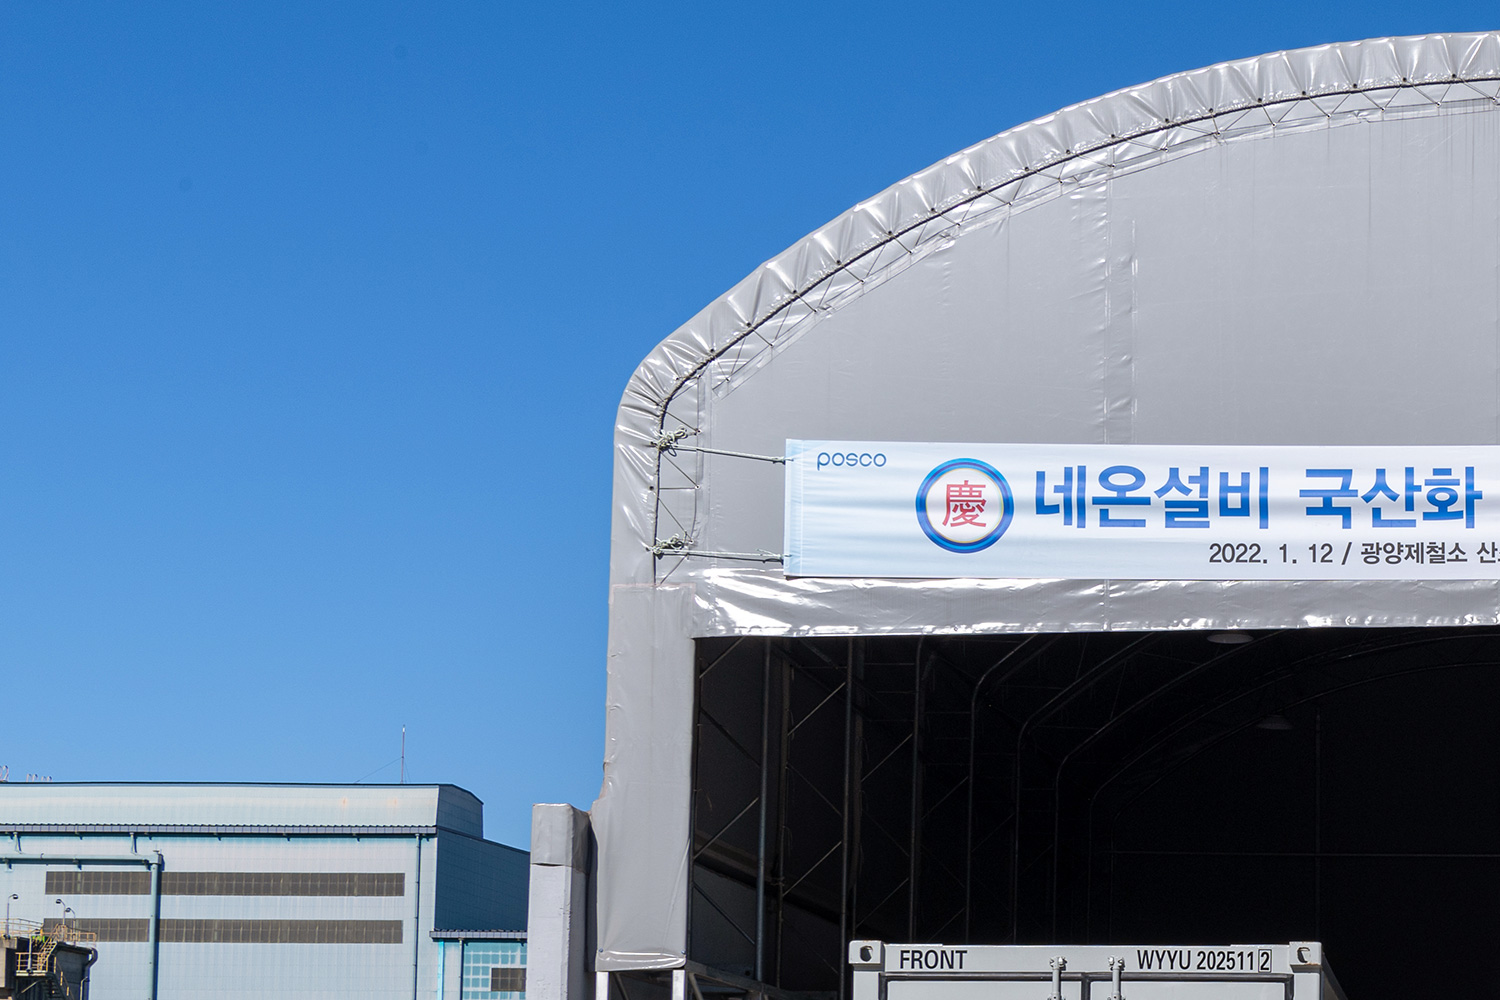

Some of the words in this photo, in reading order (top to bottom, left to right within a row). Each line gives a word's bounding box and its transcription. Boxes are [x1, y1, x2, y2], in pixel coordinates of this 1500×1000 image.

[817, 452, 886, 470] posco
[941, 480, 988, 528] 慶
[1036, 466, 1268, 529] 네온설비
[1300, 467, 1482, 529] 국산화
[1209, 543, 1267, 564] 2022.
[1279, 544, 1296, 564] 1.
[1309, 543, 1333, 562] 12
[1342, 542, 1352, 565] /
[1361, 542, 1467, 564] 광양제철소
[900, 950, 968, 970] FRONT
[1137, 950, 1191, 970] WYYU
